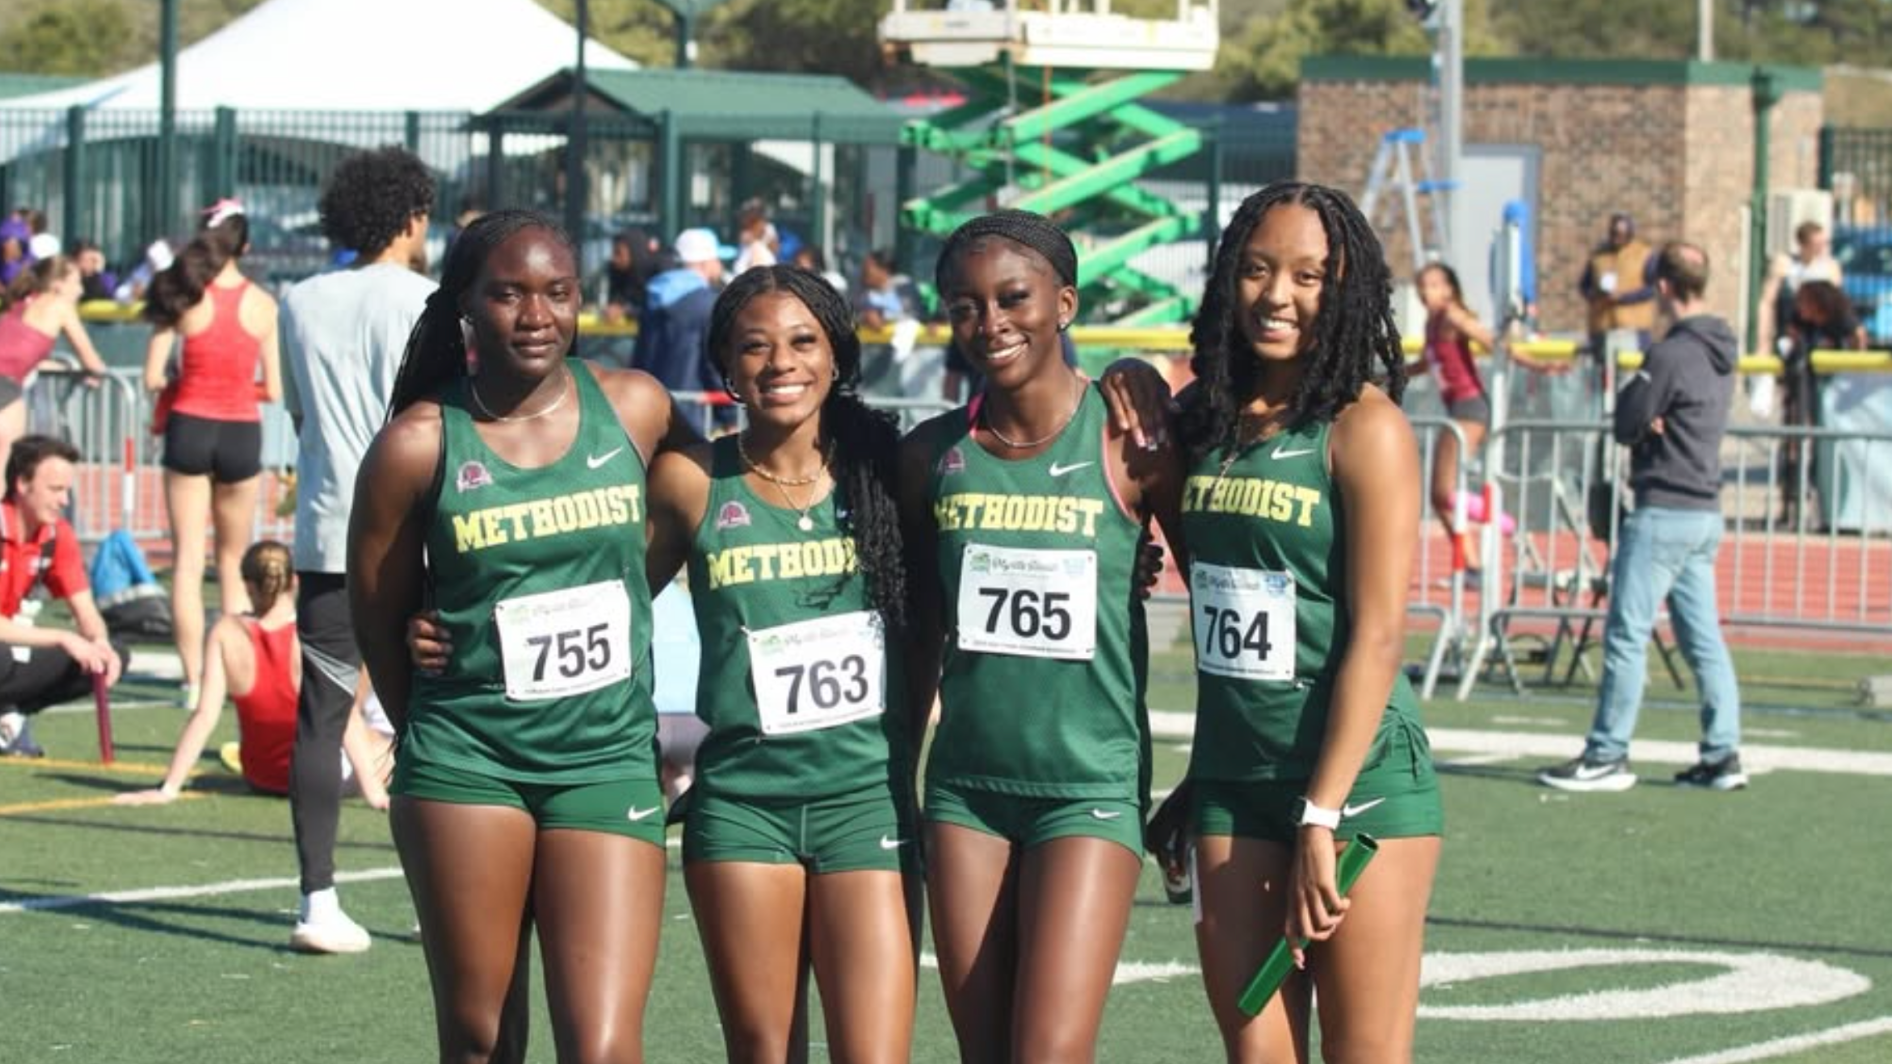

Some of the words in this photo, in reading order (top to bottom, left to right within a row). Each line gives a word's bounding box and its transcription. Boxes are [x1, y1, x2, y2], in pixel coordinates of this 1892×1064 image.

[452, 484, 640, 553] METHODIST
[1180, 475, 1320, 527] ETHODIST
[978, 587, 1072, 641] 765
[1203, 604, 1272, 661] 764
[526, 622, 611, 682] 755
[774, 654, 869, 715] 763
